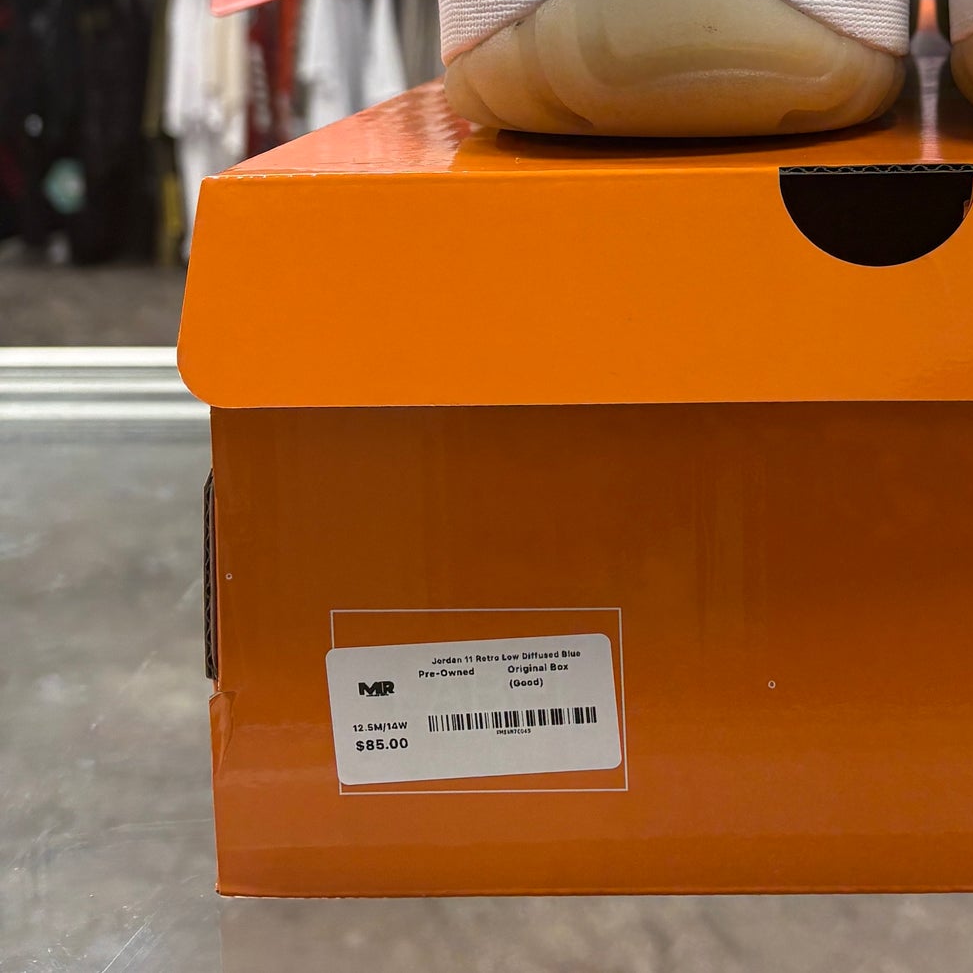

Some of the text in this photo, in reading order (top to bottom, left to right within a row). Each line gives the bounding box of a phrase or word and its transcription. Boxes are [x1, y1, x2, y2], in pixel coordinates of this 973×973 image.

[432, 657, 462, 665] Jordan
[475, 655, 499, 663] Retro
[501, 653, 519, 661] Low
[522, 651, 559, 660] Diffused
[561, 650, 581, 658] Blue
[418, 662, 569, 679] Pre-Owned Original Box
[358, 680, 395, 697] MR
[509, 678, 544, 689] (Good)
[352, 721, 408, 733] 12.5M/14W
[355, 737, 409, 752] $85.00
